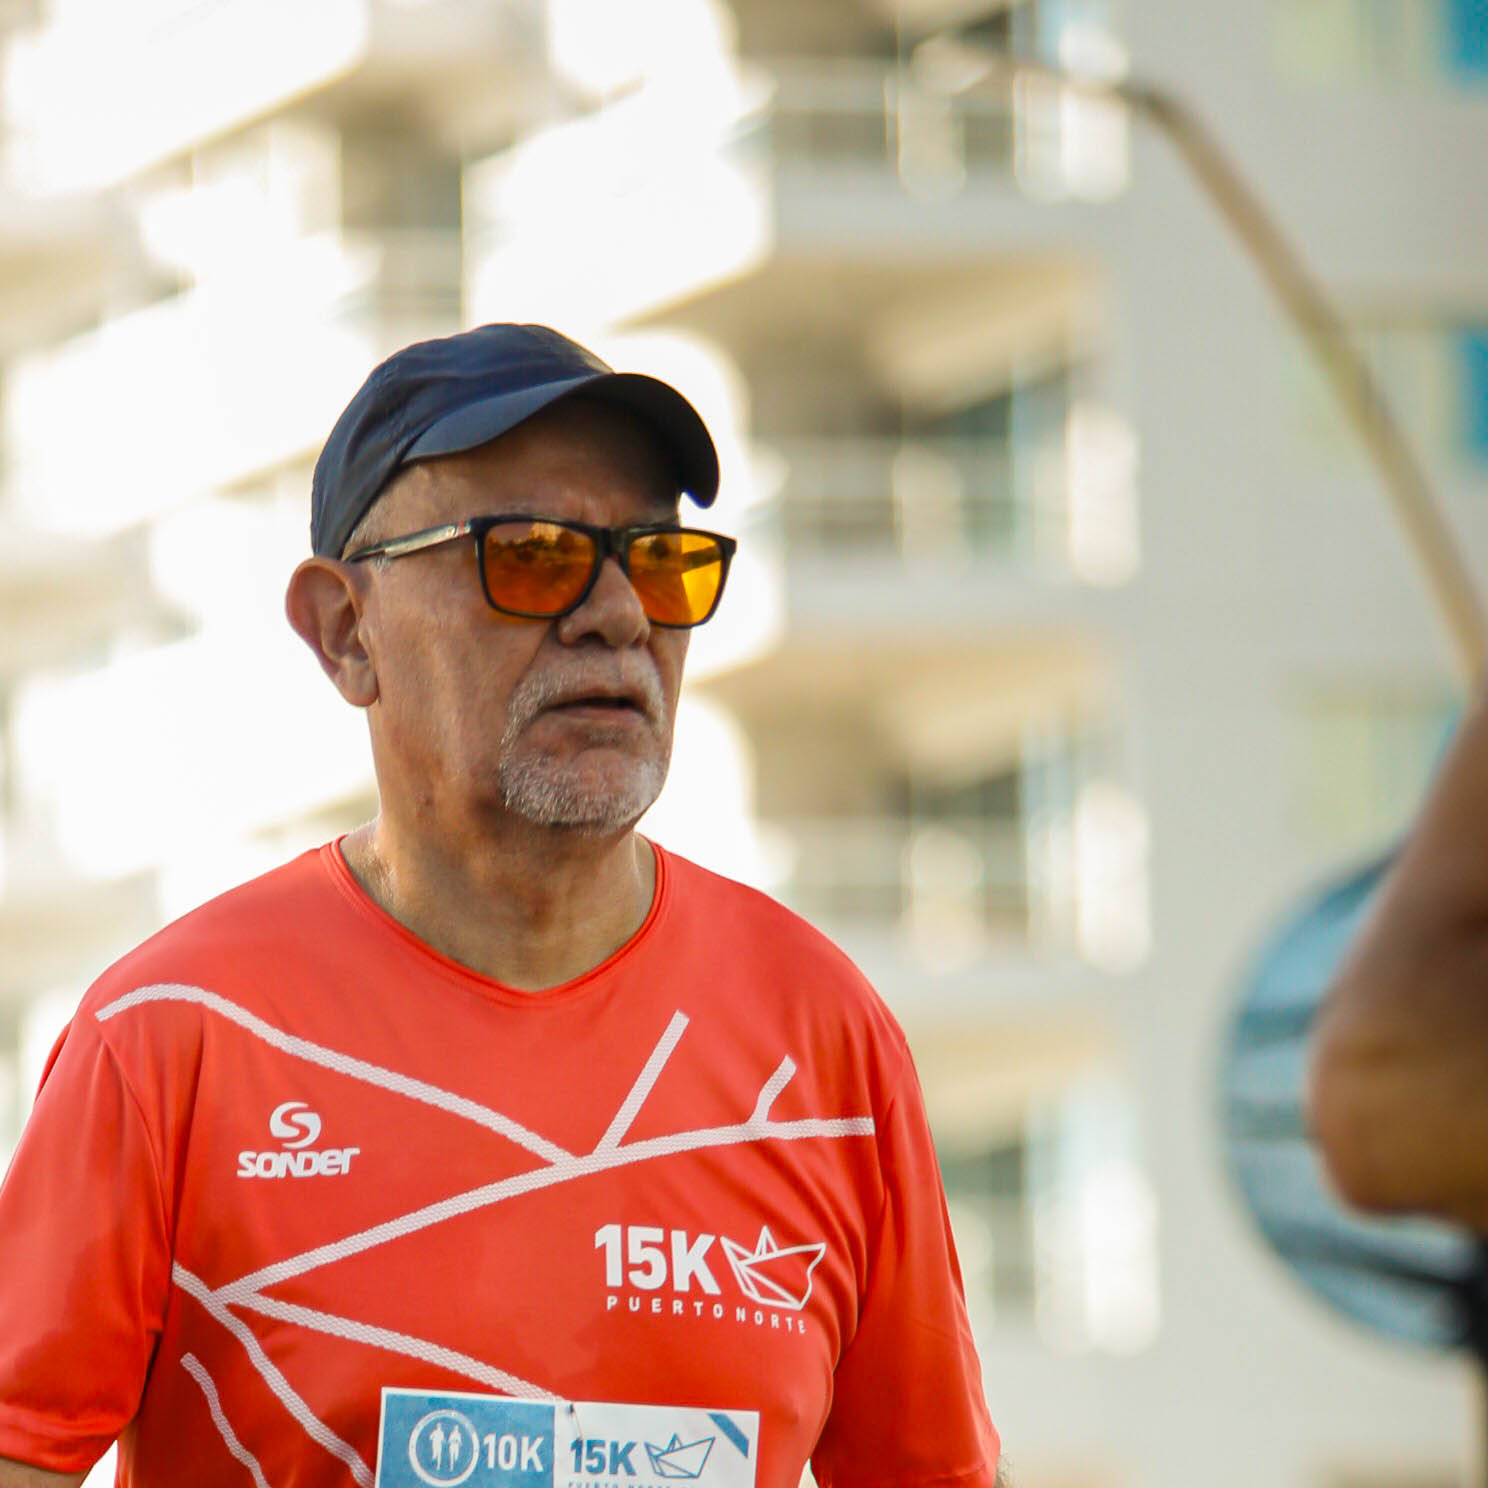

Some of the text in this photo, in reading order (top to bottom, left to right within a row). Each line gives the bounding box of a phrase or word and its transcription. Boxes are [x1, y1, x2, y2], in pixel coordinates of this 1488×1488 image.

[594, 1223, 722, 1295] 15K
[607, 1296, 805, 1333] PUERTO NORTE
[483, 1432, 543, 1473] 10K
[570, 1437, 637, 1476] 15K
